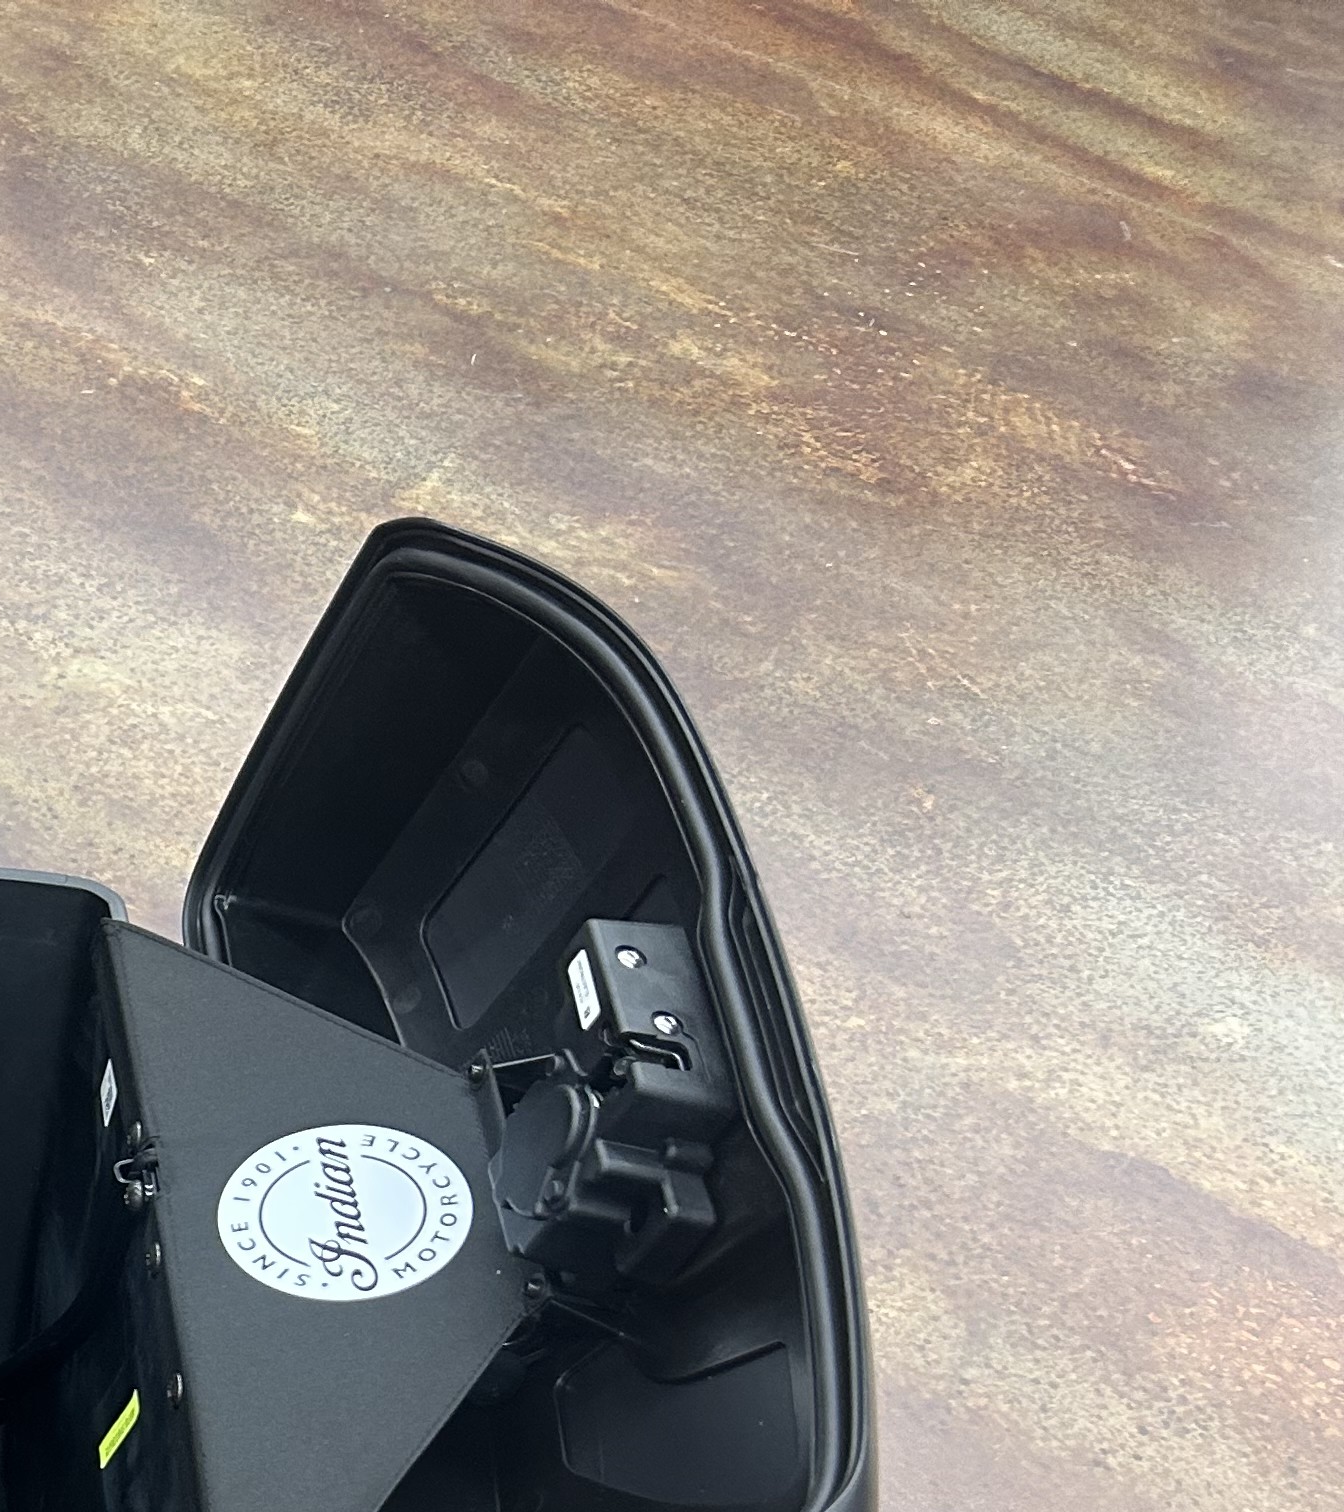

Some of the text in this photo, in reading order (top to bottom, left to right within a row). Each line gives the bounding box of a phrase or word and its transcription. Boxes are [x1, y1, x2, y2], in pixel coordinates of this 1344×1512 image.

[231, 1151, 311, 1287] SINCE 1901
[308, 1136, 379, 1291] Indian
[361, 1134, 459, 1279] MOTORCYCLE
